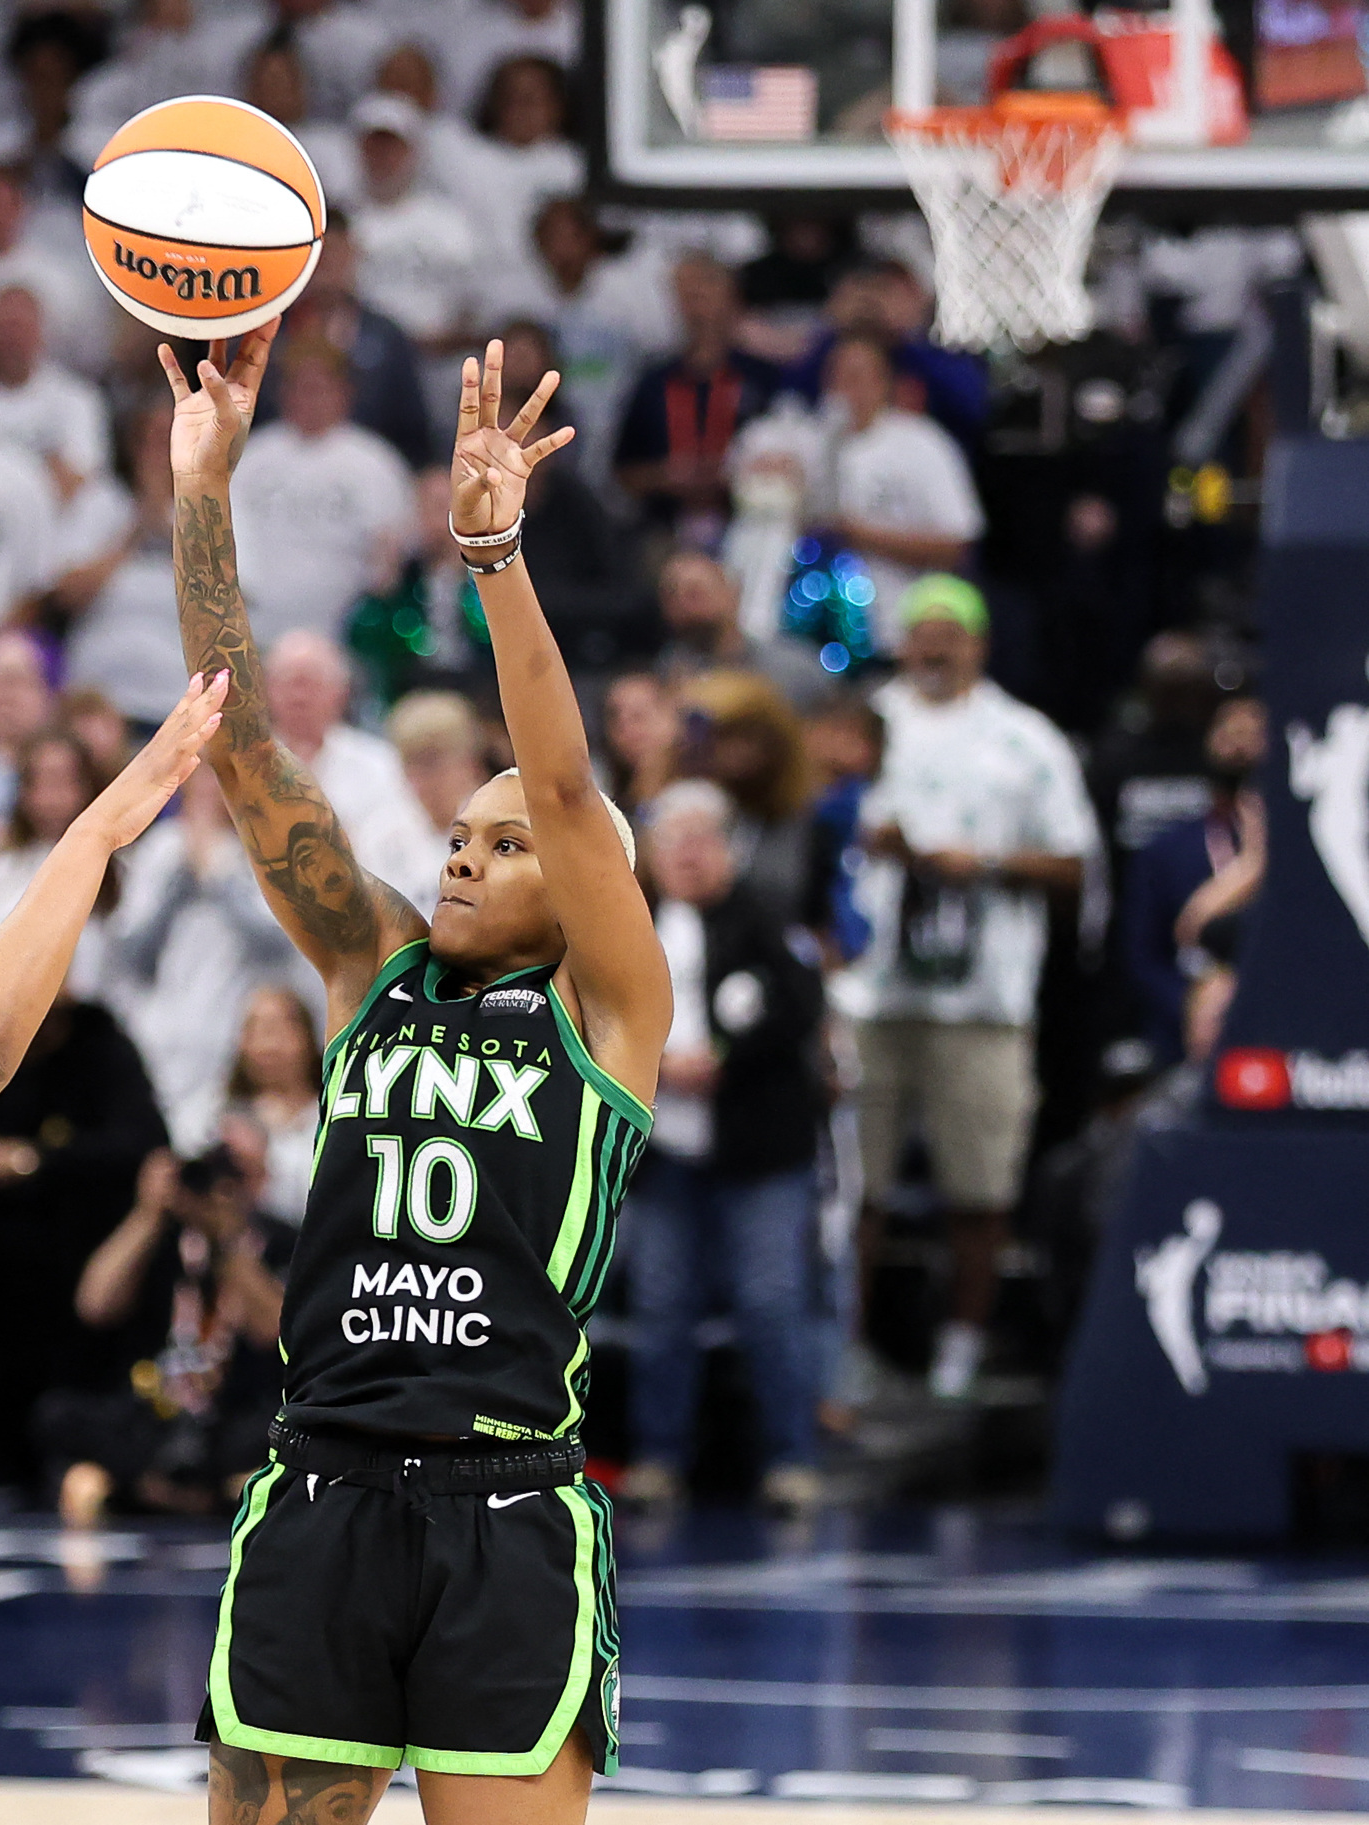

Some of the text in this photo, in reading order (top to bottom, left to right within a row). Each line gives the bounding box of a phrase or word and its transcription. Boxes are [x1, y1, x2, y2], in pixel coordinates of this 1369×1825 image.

[114, 239, 263, 302] Wilson
[482, 533, 513, 545] SCARED
[481, 988, 547, 1006] FEDERATED
[331, 1044, 550, 1142] LYNX
[366, 1134, 478, 1244] 10
[351, 1262, 483, 1302] MAYO
[341, 1305, 491, 1347] CLINIC
[1205, 1281, 1369, 1334] FINA
[473, 1421, 495, 1436] NIKE
[475, 1414, 532, 1436] MINNESOTA
